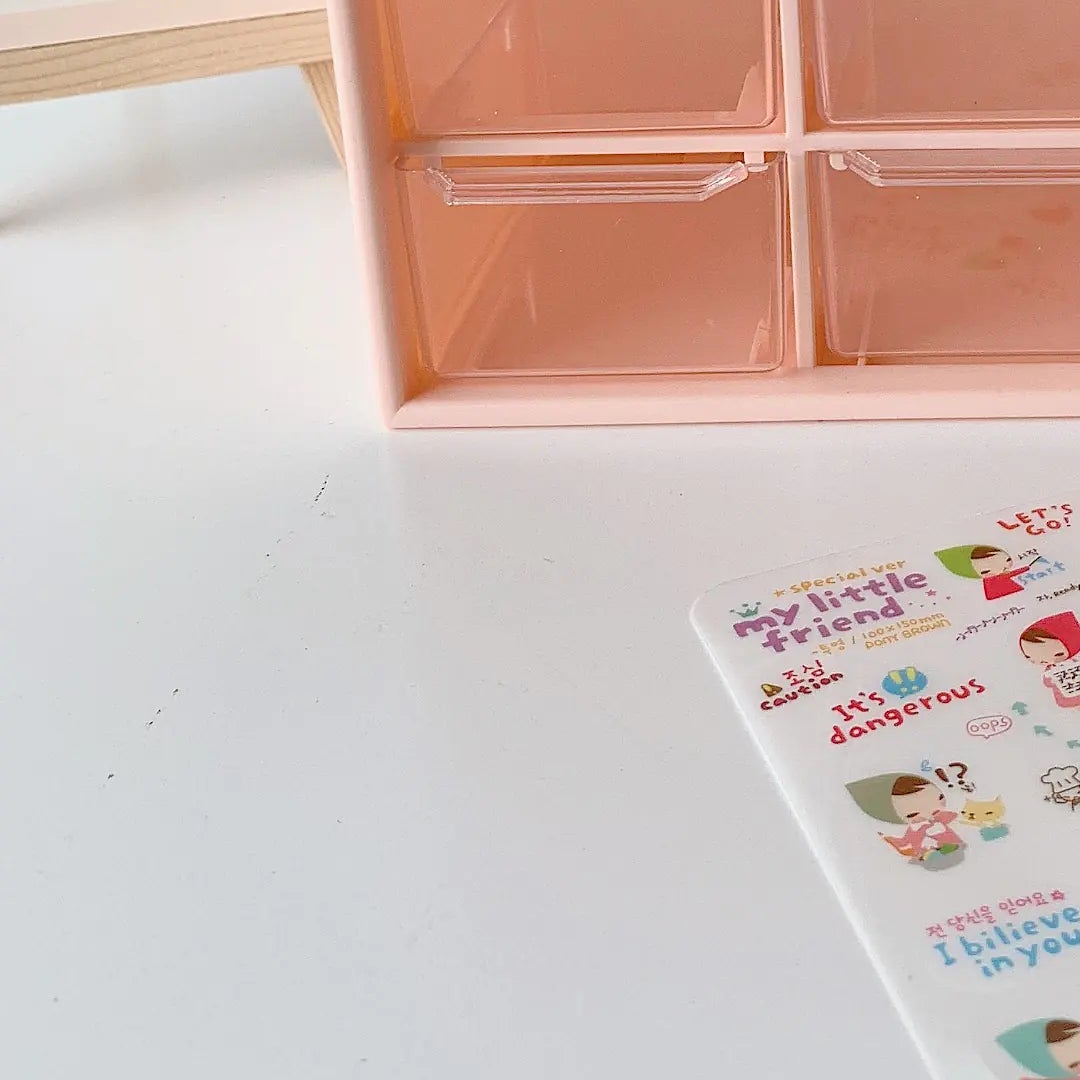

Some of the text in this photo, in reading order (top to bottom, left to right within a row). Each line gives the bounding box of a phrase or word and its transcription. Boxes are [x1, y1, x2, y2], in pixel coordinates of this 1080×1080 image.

[996, 503, 1074, 531] LET'S
[1025, 516, 1072, 536] GO!
[732, 572, 928, 638] my little
[761, 596, 905, 653] friend
[782, 659, 825, 687] 조심
[760, 672, 844, 711] caution
[831, 691, 886, 721] It's
[830, 678, 987, 745] dangerous
[933, 906, 1080, 966] I bilieve
[974, 955, 1015, 978] in
